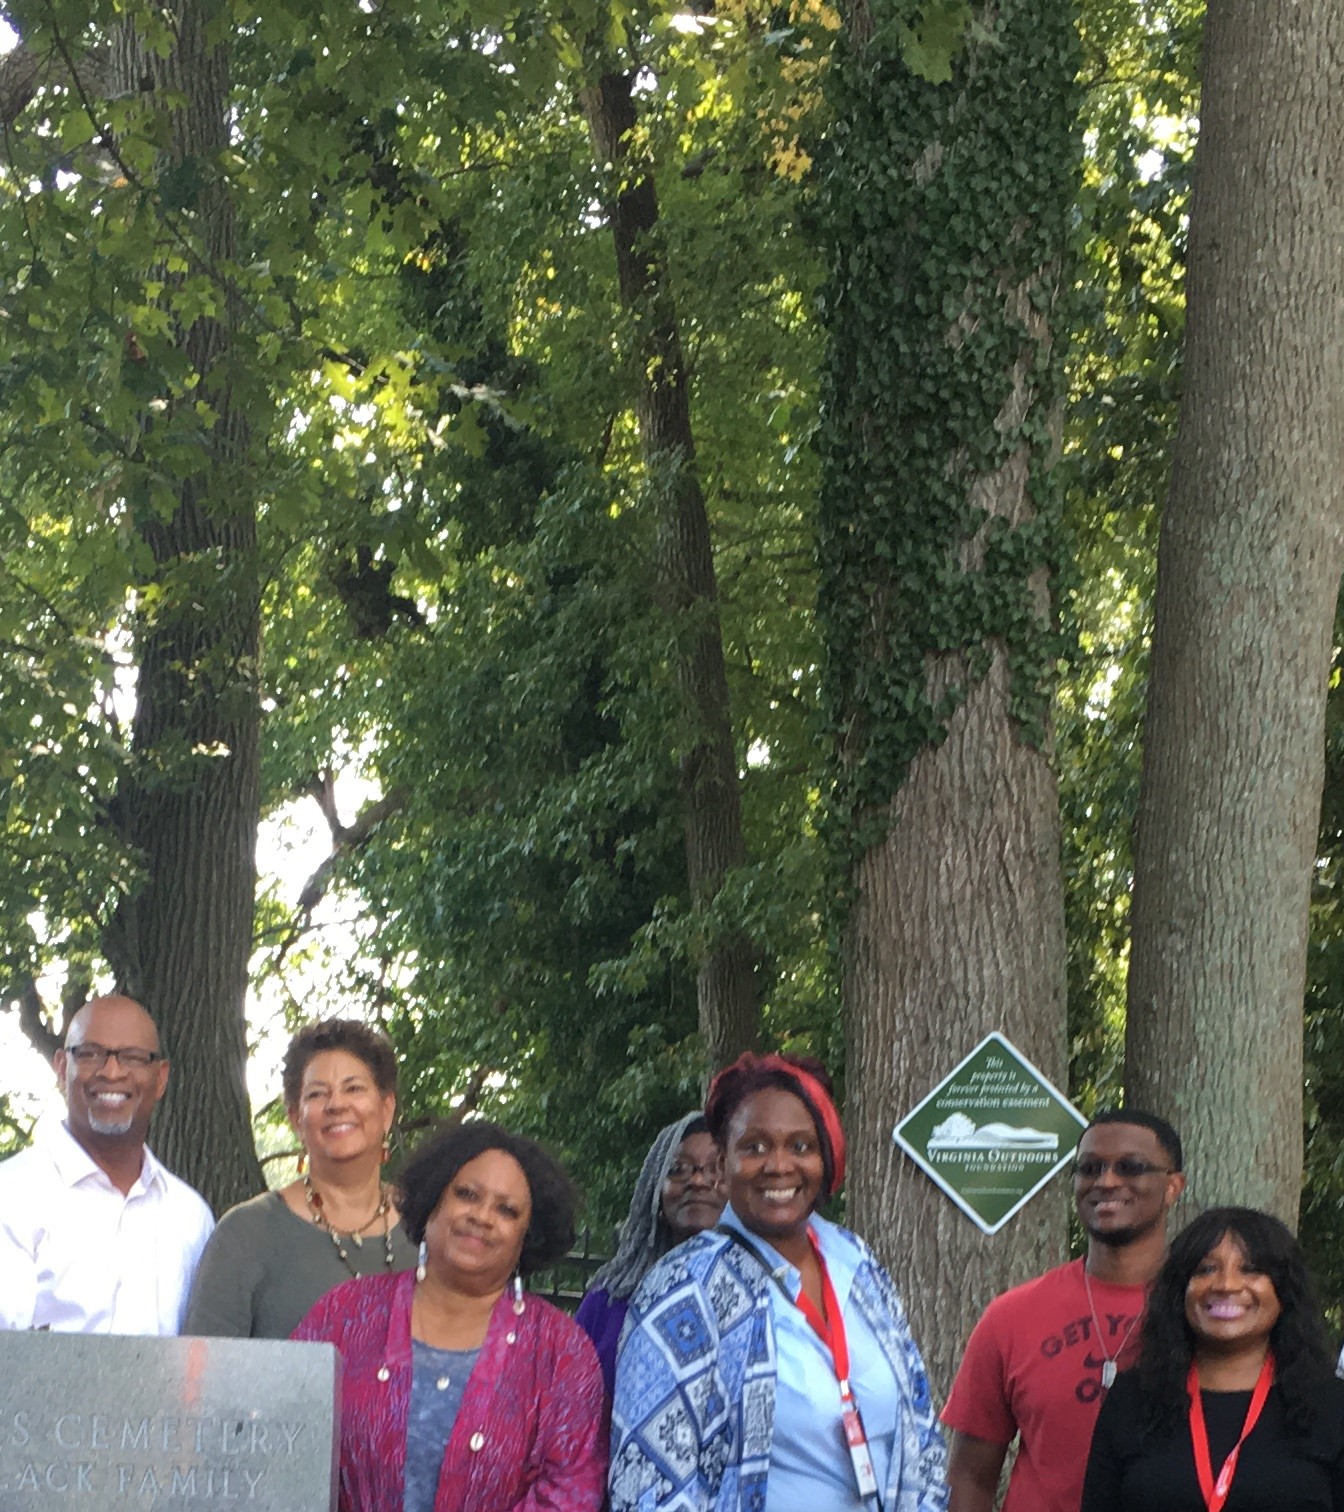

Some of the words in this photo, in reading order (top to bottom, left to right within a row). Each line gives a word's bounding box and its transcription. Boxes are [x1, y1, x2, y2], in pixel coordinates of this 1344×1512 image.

[936, 1096, 1000, 1109] conservation
[1002, 1097, 1050, 1109] easement
[1040, 1315, 1093, 1358] GET
[55, 1412, 306, 1455] CEMETERY
[116, 1463, 266, 1499] FAMILY
